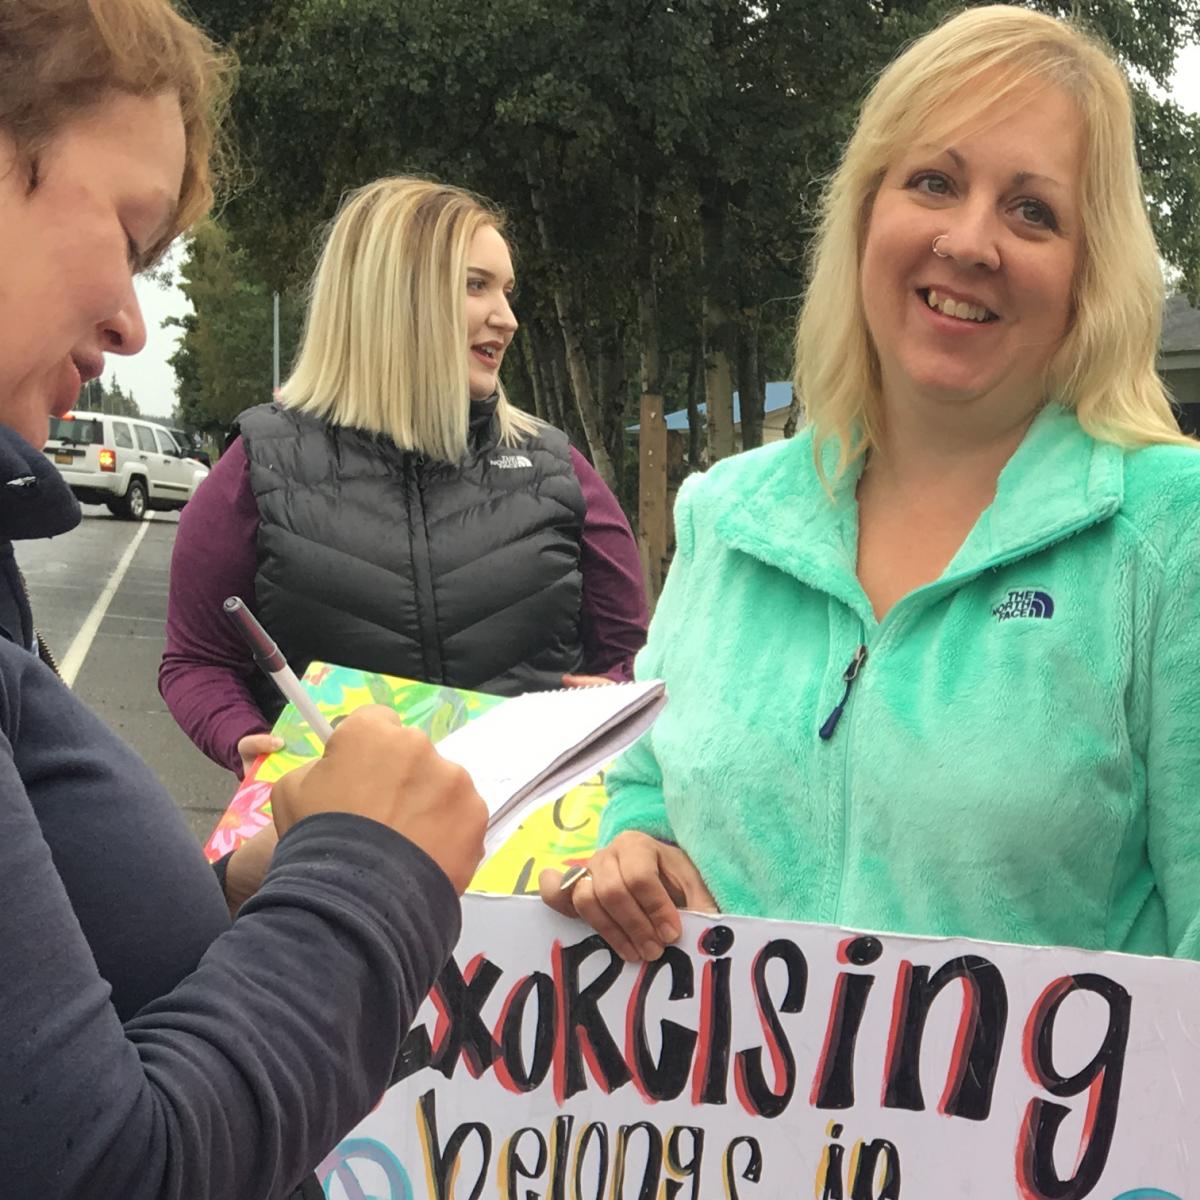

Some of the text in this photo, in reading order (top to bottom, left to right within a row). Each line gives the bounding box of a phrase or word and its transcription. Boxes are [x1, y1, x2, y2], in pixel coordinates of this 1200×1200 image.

[1008, 591, 1034, 602] THE
[992, 600, 1031, 616] NORTH
[998, 610, 1028, 623] FACE
